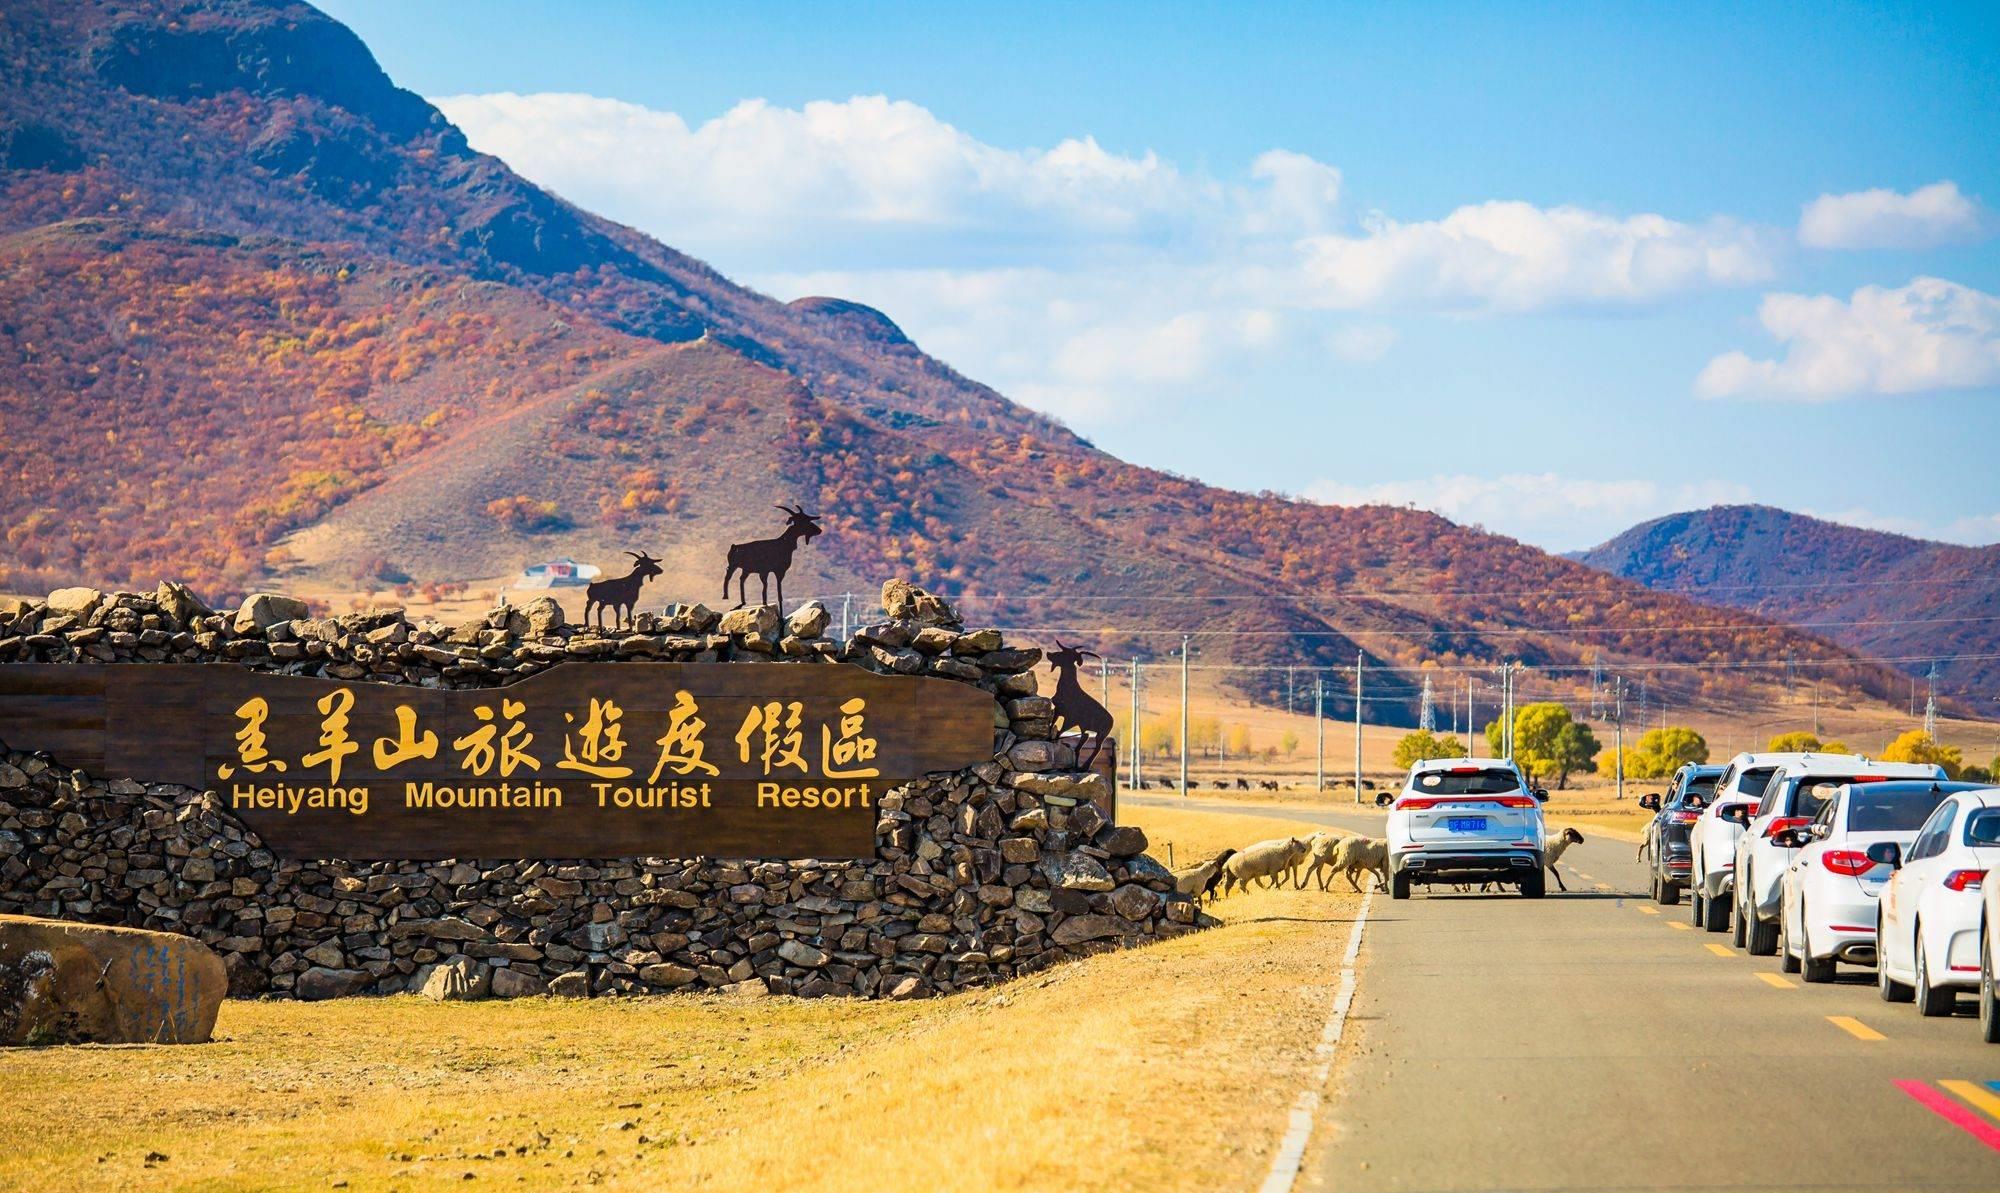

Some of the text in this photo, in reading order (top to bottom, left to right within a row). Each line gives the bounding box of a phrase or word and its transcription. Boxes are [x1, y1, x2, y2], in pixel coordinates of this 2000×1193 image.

[232, 784, 871, 815] Heiyang Mountain Tourist Resort
